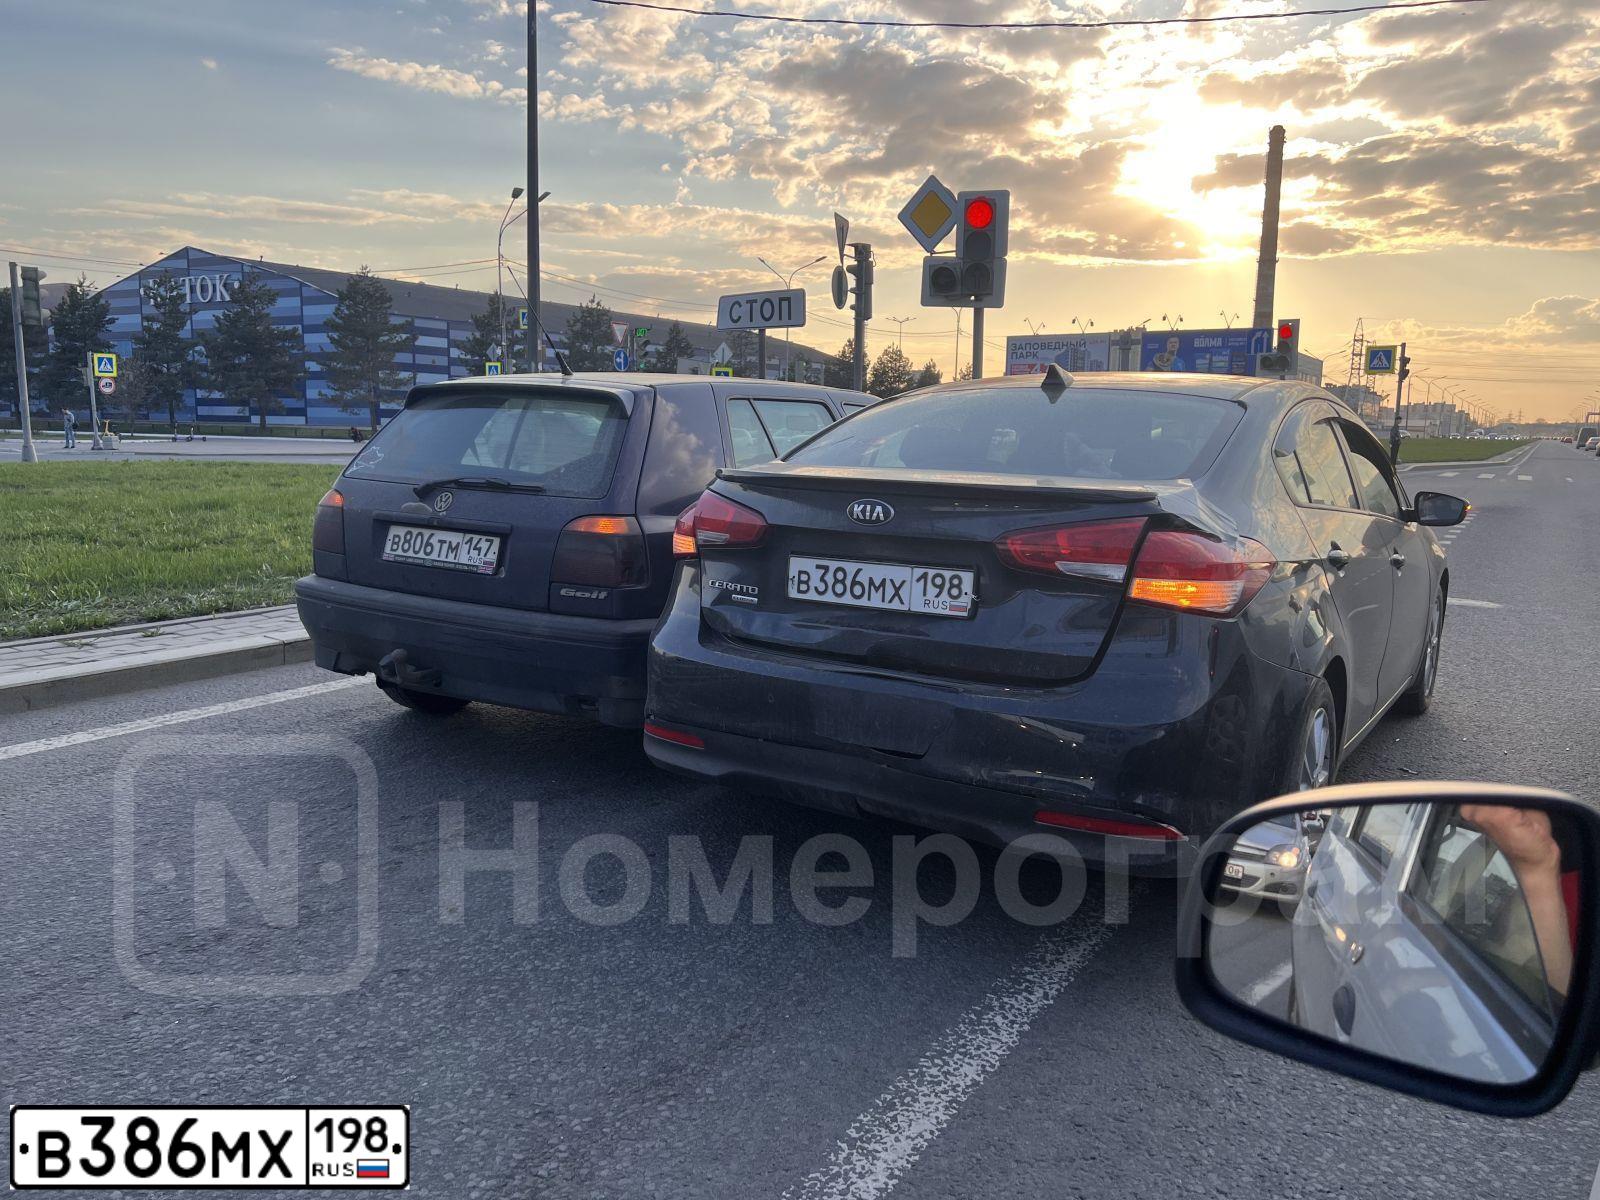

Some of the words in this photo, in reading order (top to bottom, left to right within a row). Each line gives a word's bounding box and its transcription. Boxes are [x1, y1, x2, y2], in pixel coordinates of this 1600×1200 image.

[729, 296, 791, 324] СТОП
[1010, 339, 1087, 351] ЗАПОВЕДНЫЙ
[1010, 351, 1039, 360] ПАРК
[853, 504, 886, 521] KIA
[390, 530, 462, 560] В806ТМ
[464, 537, 494, 557] 147
[467, 555, 483, 565] RUS
[708, 579, 759, 595] CERATO
[796, 564, 907, 605] В386МХ
[916, 571, 964, 600] 198
[560, 588, 608, 600] Golf
[923, 598, 949, 610] RUS
